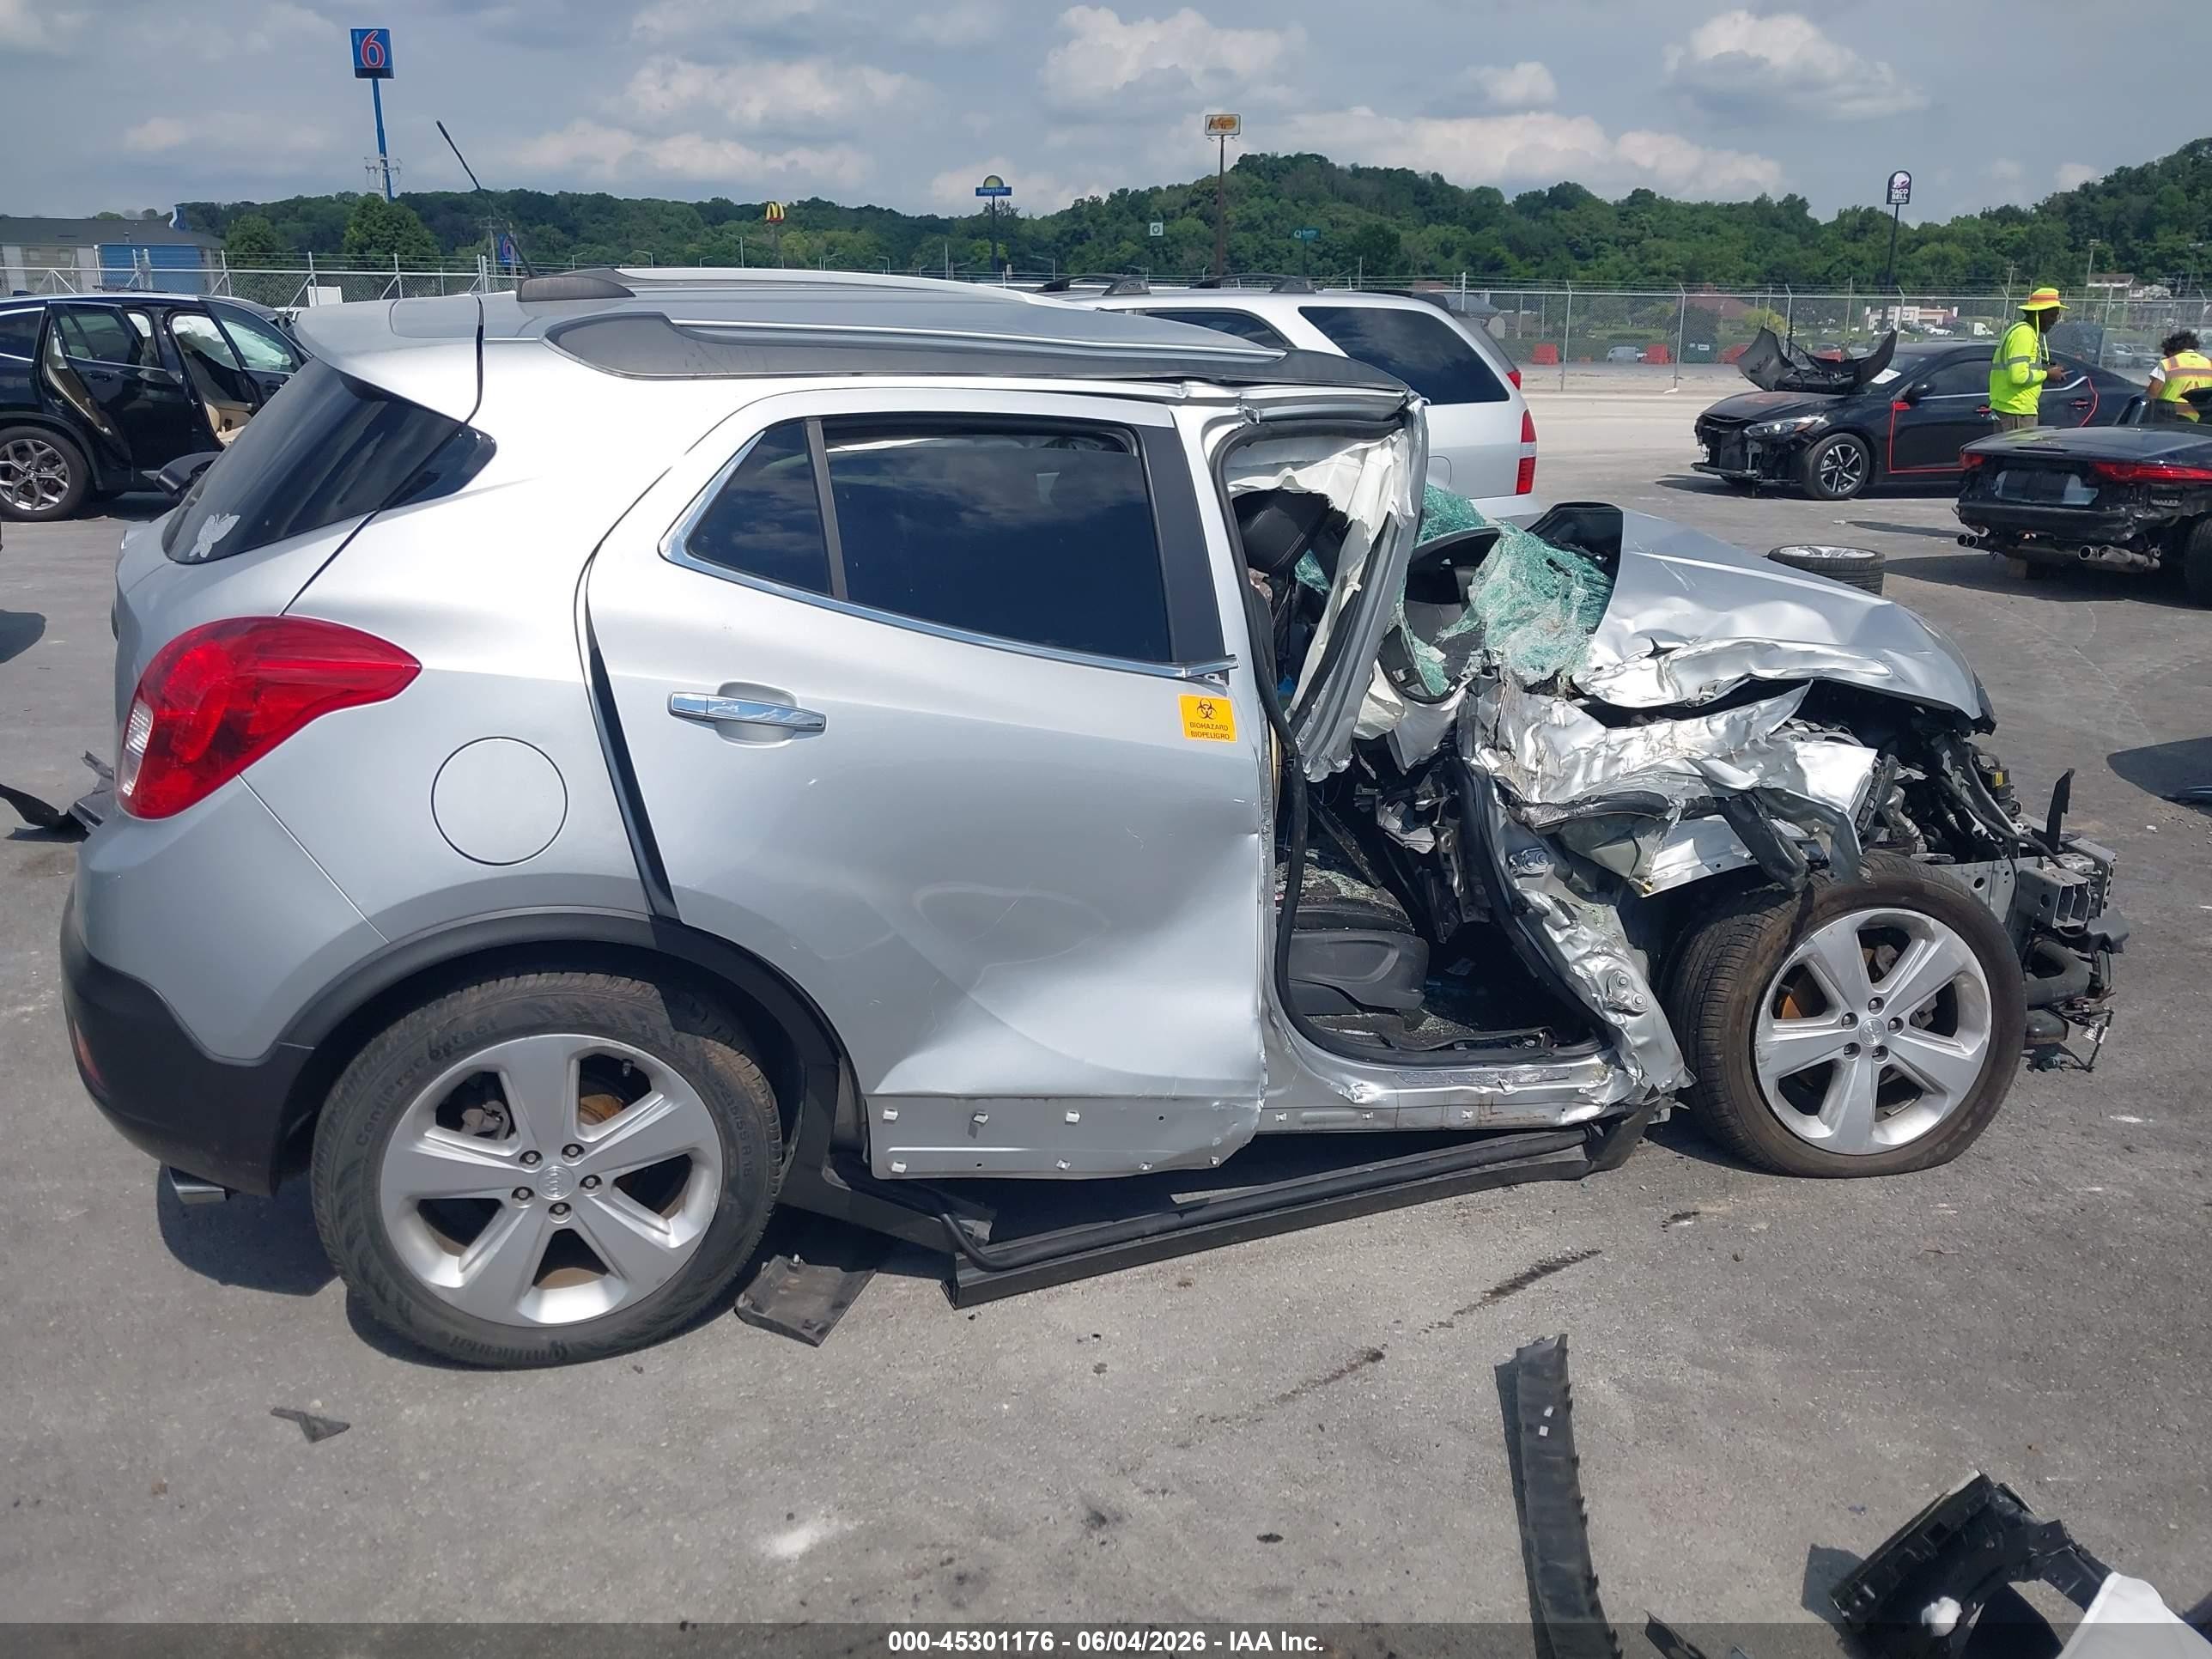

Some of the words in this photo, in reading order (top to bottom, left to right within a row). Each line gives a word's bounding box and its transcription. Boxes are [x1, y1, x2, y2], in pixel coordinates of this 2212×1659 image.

[361, 30, 386, 69] 6
[1189, 722, 1229, 732] BIOHAZARD
[1190, 731, 1231, 740] BIOPELIGRO
